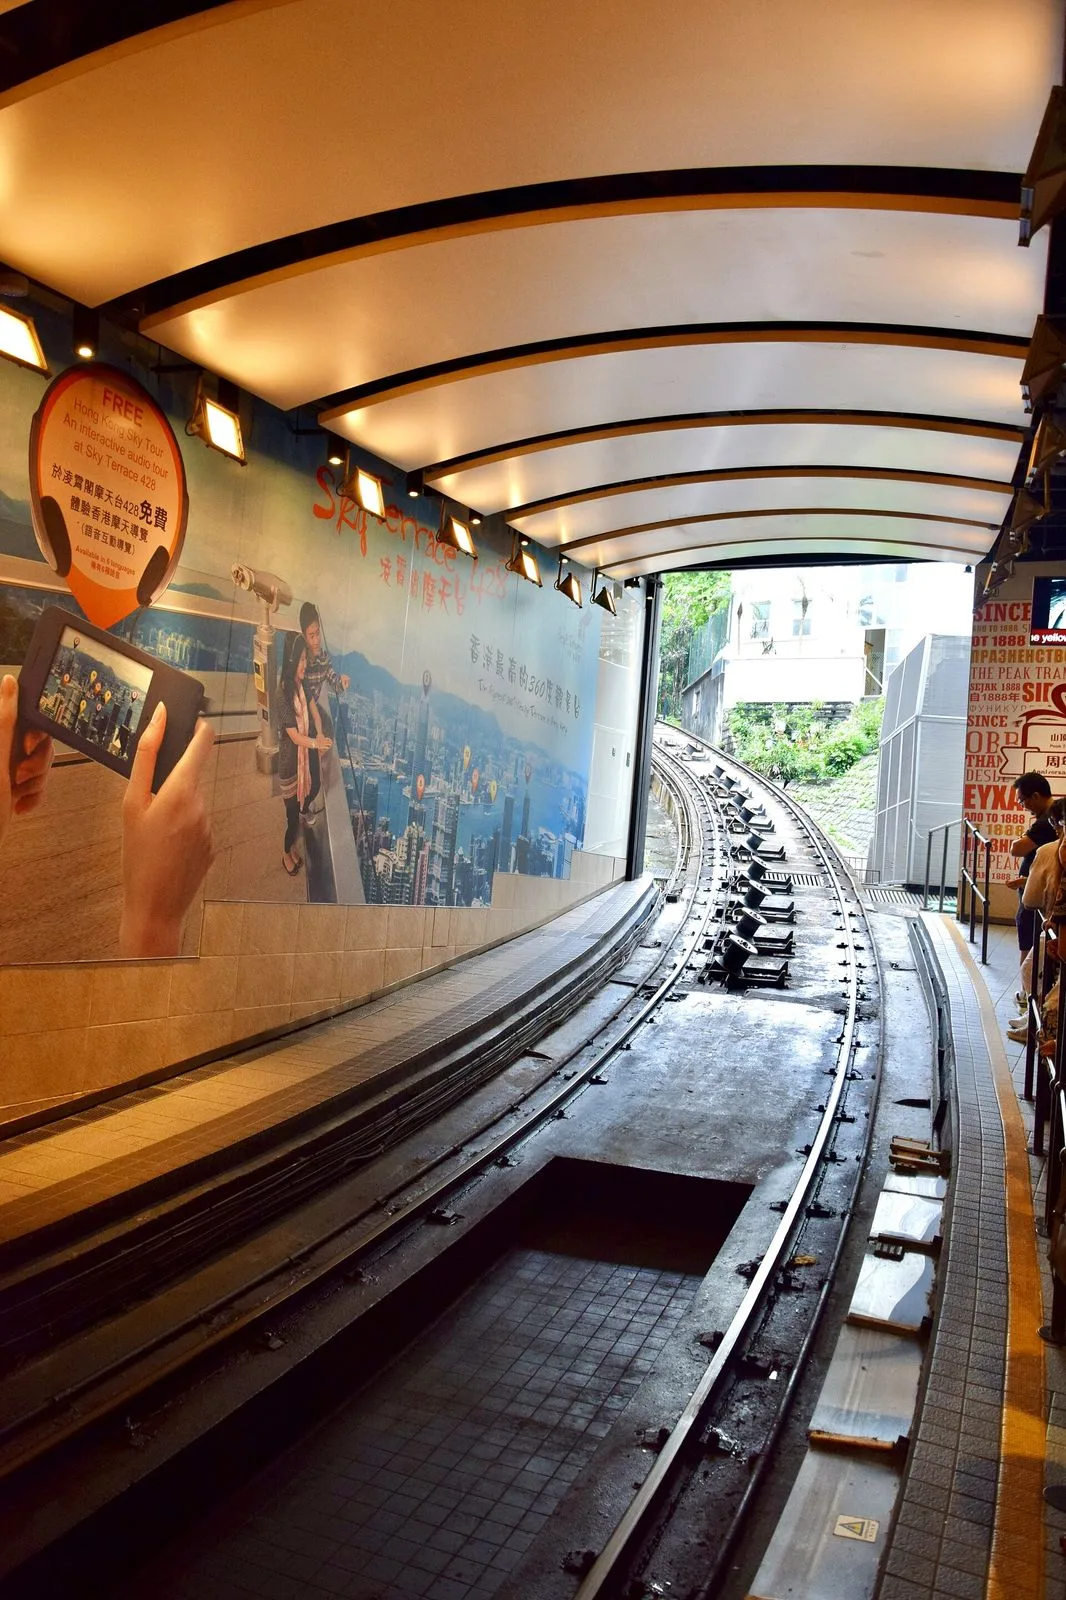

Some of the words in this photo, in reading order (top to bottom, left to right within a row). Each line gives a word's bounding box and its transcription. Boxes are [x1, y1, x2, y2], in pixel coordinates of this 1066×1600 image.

[103, 388, 143, 428] FREE
[74, 397, 99, 425] Hong
[102, 412, 124, 439] Kong
[127, 429, 143, 450] Sky
[145, 438, 164, 458] Tour
[63, 413, 77, 430] An
[80, 422, 126, 456] interactive
[128, 449, 151, 470] audio
[152, 461, 169, 480] tour
[73, 441, 83, 455] at
[86, 444, 104, 467] Sky
[106, 454, 138, 483] Terrace
[140, 474, 156, 492] 428
[992, 635, 1026, 647] 1888
[971, 666, 993, 680] THE
[998, 666, 1031, 680] PEAK
[1036, 666, 1066, 680] TRA
[970, 683, 997, 693] SEJAK
[1001, 682, 1021, 692] 1888
[967, 714, 1008, 728] SINCE
[1000, 814, 1025, 824] 1888
[987, 823, 1024, 836] 1888
